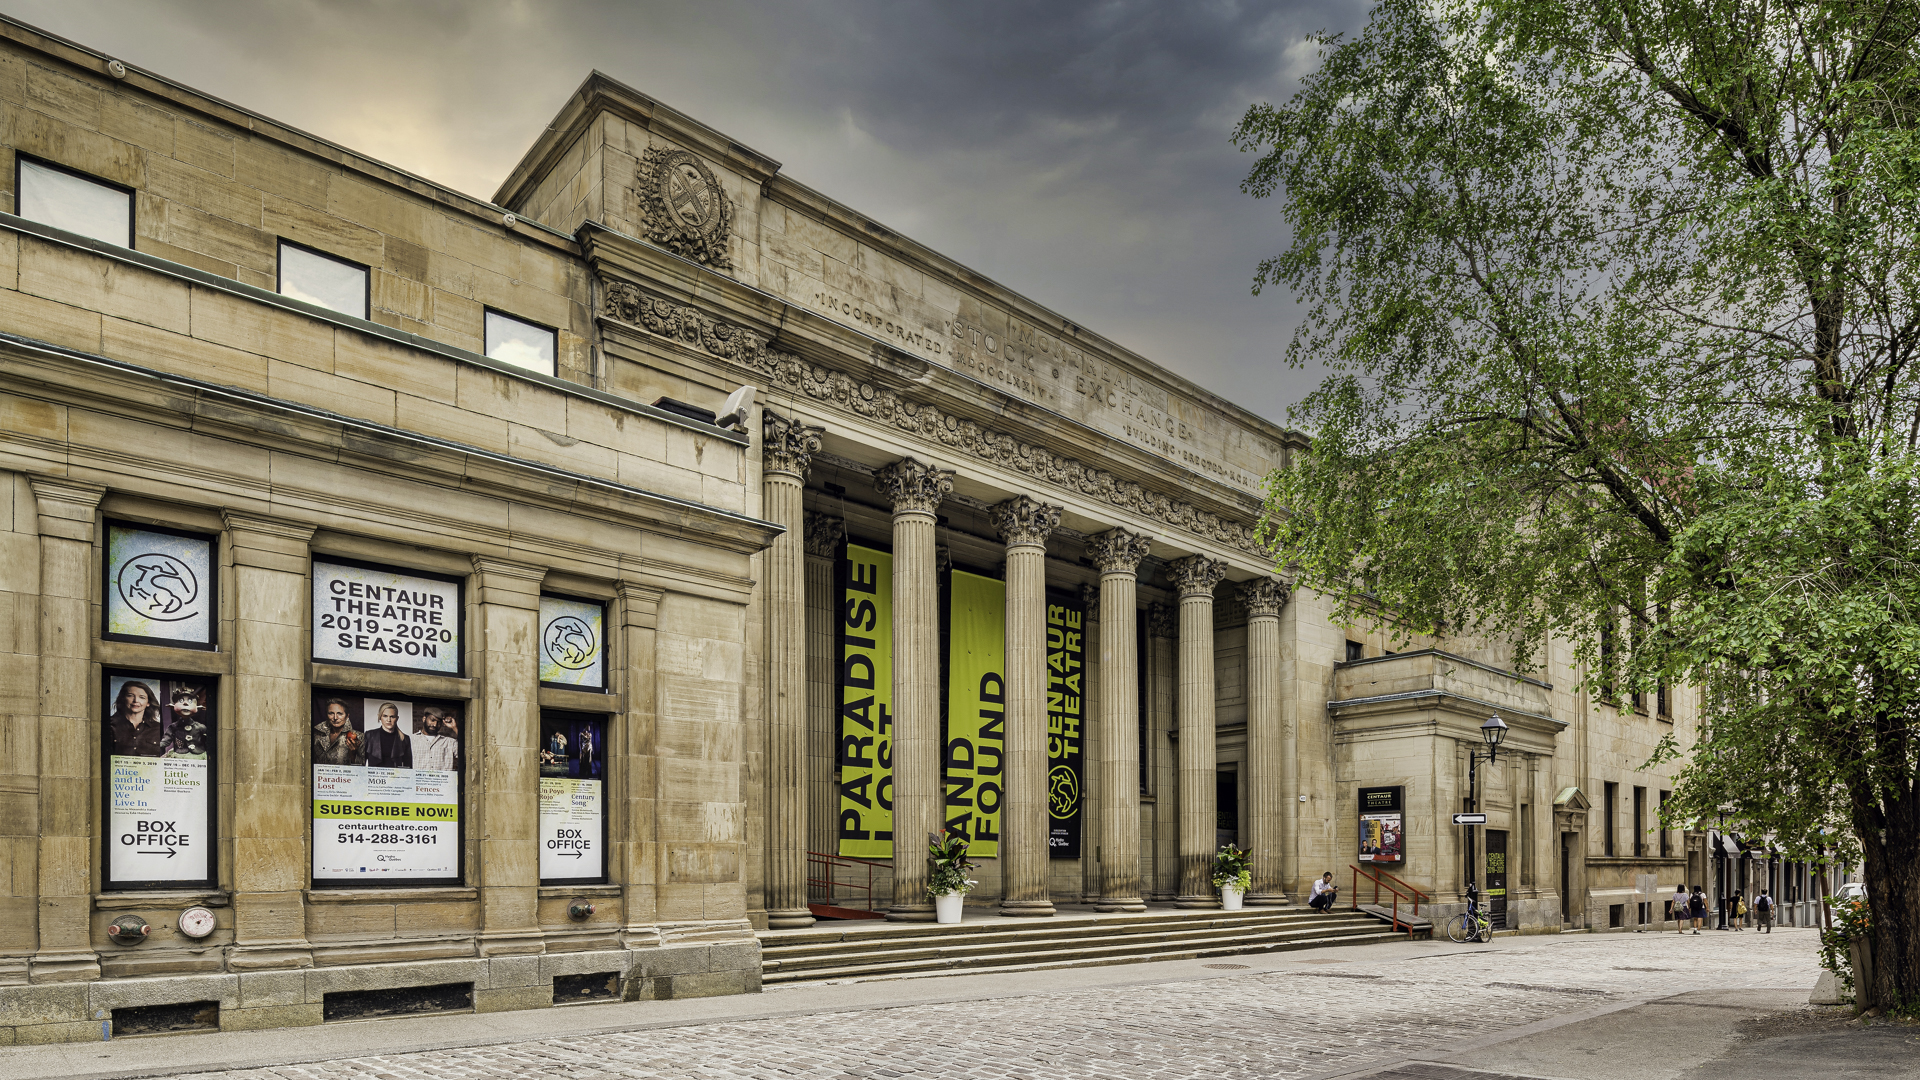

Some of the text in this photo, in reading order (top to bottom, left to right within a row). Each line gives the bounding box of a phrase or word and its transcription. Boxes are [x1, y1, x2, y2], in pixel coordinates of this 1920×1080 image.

[821, 292, 942, 354] INCORPORATED
[1018, 324, 1139, 397] MONTREAL
[952, 320, 1188, 440] STOCK EXCHANGE
[330, 579, 444, 610] CENTAUR
[330, 596, 443, 626] THEATRE
[321, 613, 452, 643] 2019-2020
[338, 633, 437, 658] SEASON
[1048, 603, 1065, 759] CENTAUR
[1064, 607, 1082, 759] THEATRE
[839, 558, 877, 841] PARADISE
[974, 671, 1005, 842] FOUND
[114, 768, 139, 776] Alice
[164, 770, 189, 778] Little
[114, 776, 151, 784] and the
[164, 778, 201, 786] Dickens
[317, 775, 352, 783] Paradise
[114, 791, 130, 799] We
[415, 785, 440, 793] Fences
[549, 788, 565, 796] Poyo
[945, 736, 975, 843] AND
[320, 804, 453, 818] SUBSCRIBE NOW!
[137, 820, 176, 833] BOX
[338, 823, 438, 832] centaurtheatre.com
[121, 833, 190, 846] OFFICE
[337, 833, 437, 845] 514-288-3161
[557, 829, 582, 839] BOX
[547, 840, 591, 849] OFFICE
